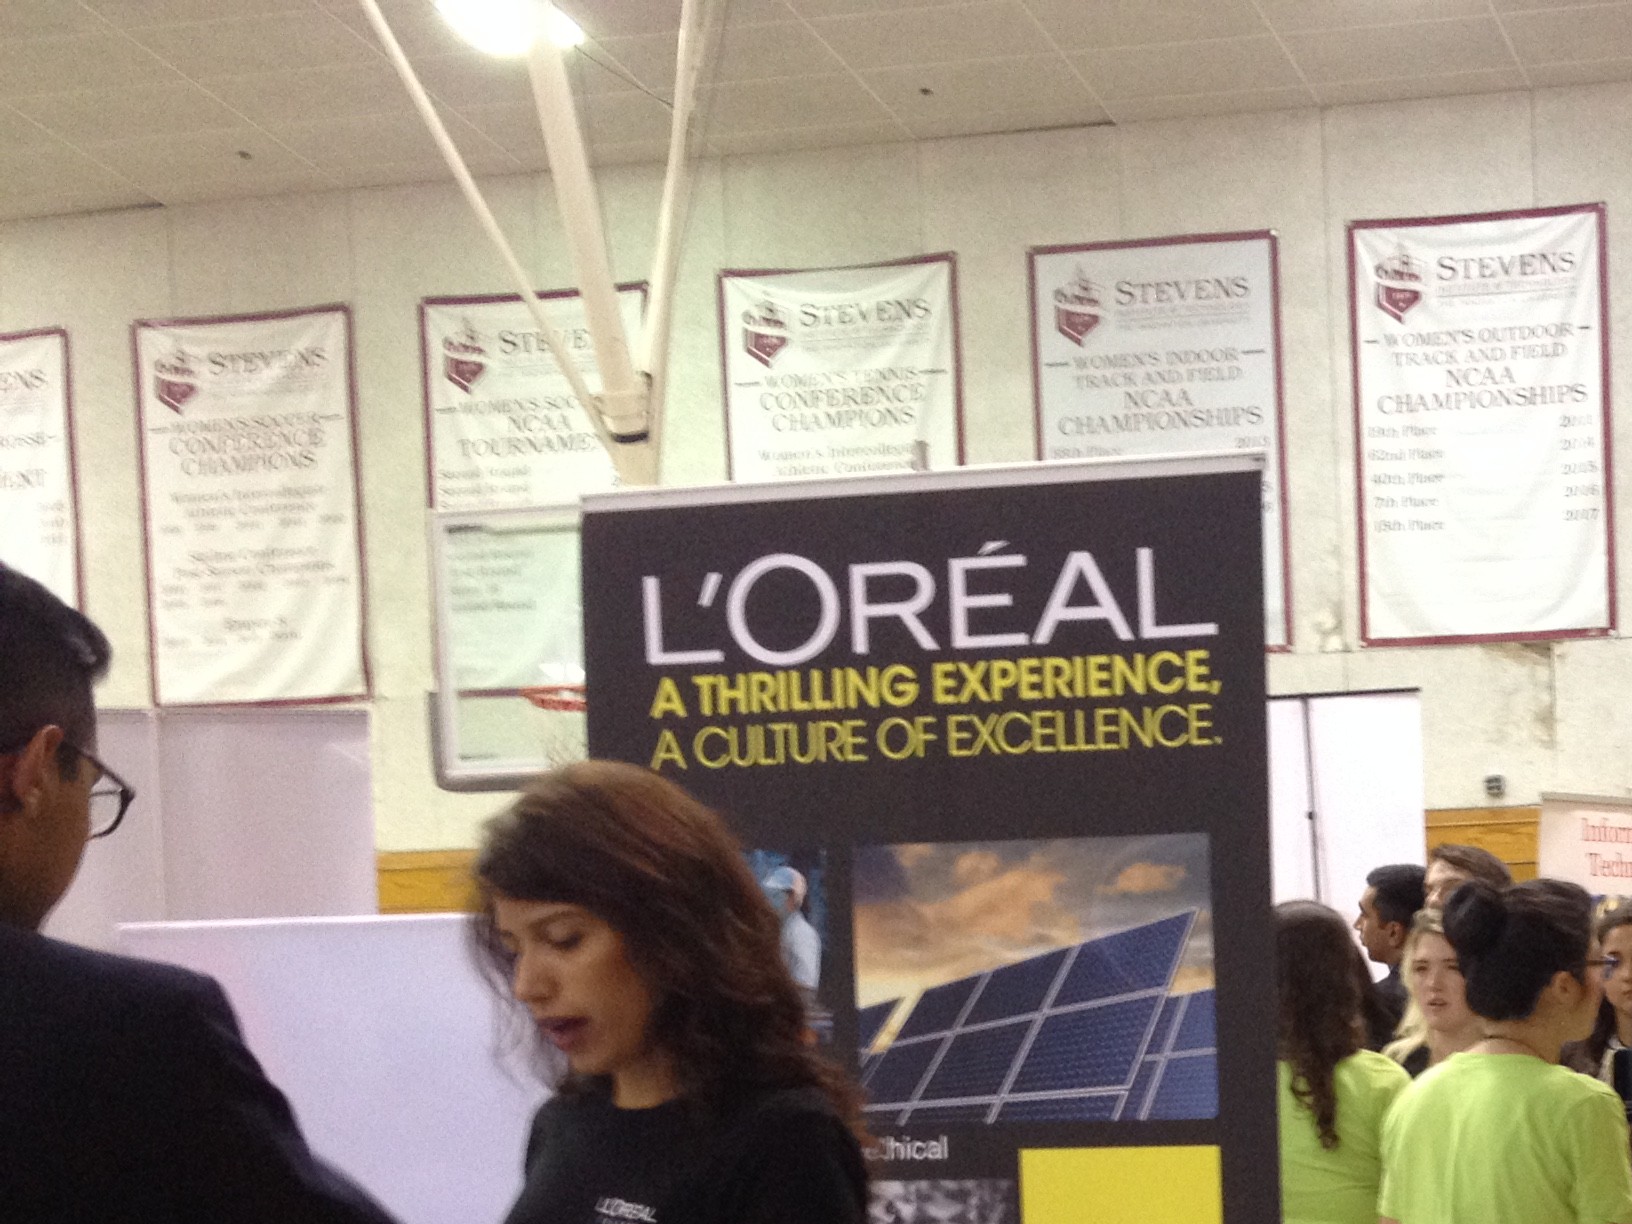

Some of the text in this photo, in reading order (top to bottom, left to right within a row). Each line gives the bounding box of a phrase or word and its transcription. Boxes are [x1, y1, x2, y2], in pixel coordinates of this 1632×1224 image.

[1436, 252, 1576, 281] STEVENS
[1113, 275, 1250, 306] STEVENS
[800, 298, 931, 327] STEVENS
[1383, 323, 1574, 347] WOMEN'S OUTDOOR
[1071, 347, 1239, 369] WOMEN'S INDOOR
[1392, 343, 1568, 367] TRACK AND FIELD
[1075, 366, 1243, 389] TRACK AND FIELD
[1446, 367, 1517, 388] NCAA
[759, 383, 926, 411] CONFERENCE
[1123, 389, 1194, 409] NCAA
[1376, 384, 1589, 415] CHAMPIONSHIPS
[771, 405, 915, 432] CHAMPIONS
[1057, 405, 1264, 435] CHAMPIONSHIPS
[642, 540, 1219, 666] L'ORÉAL
[650, 649, 1223, 718] A THRILLING EXPERIENCE,
[650, 702, 1223, 771] A CULTURE OF EXCELLENCE.
